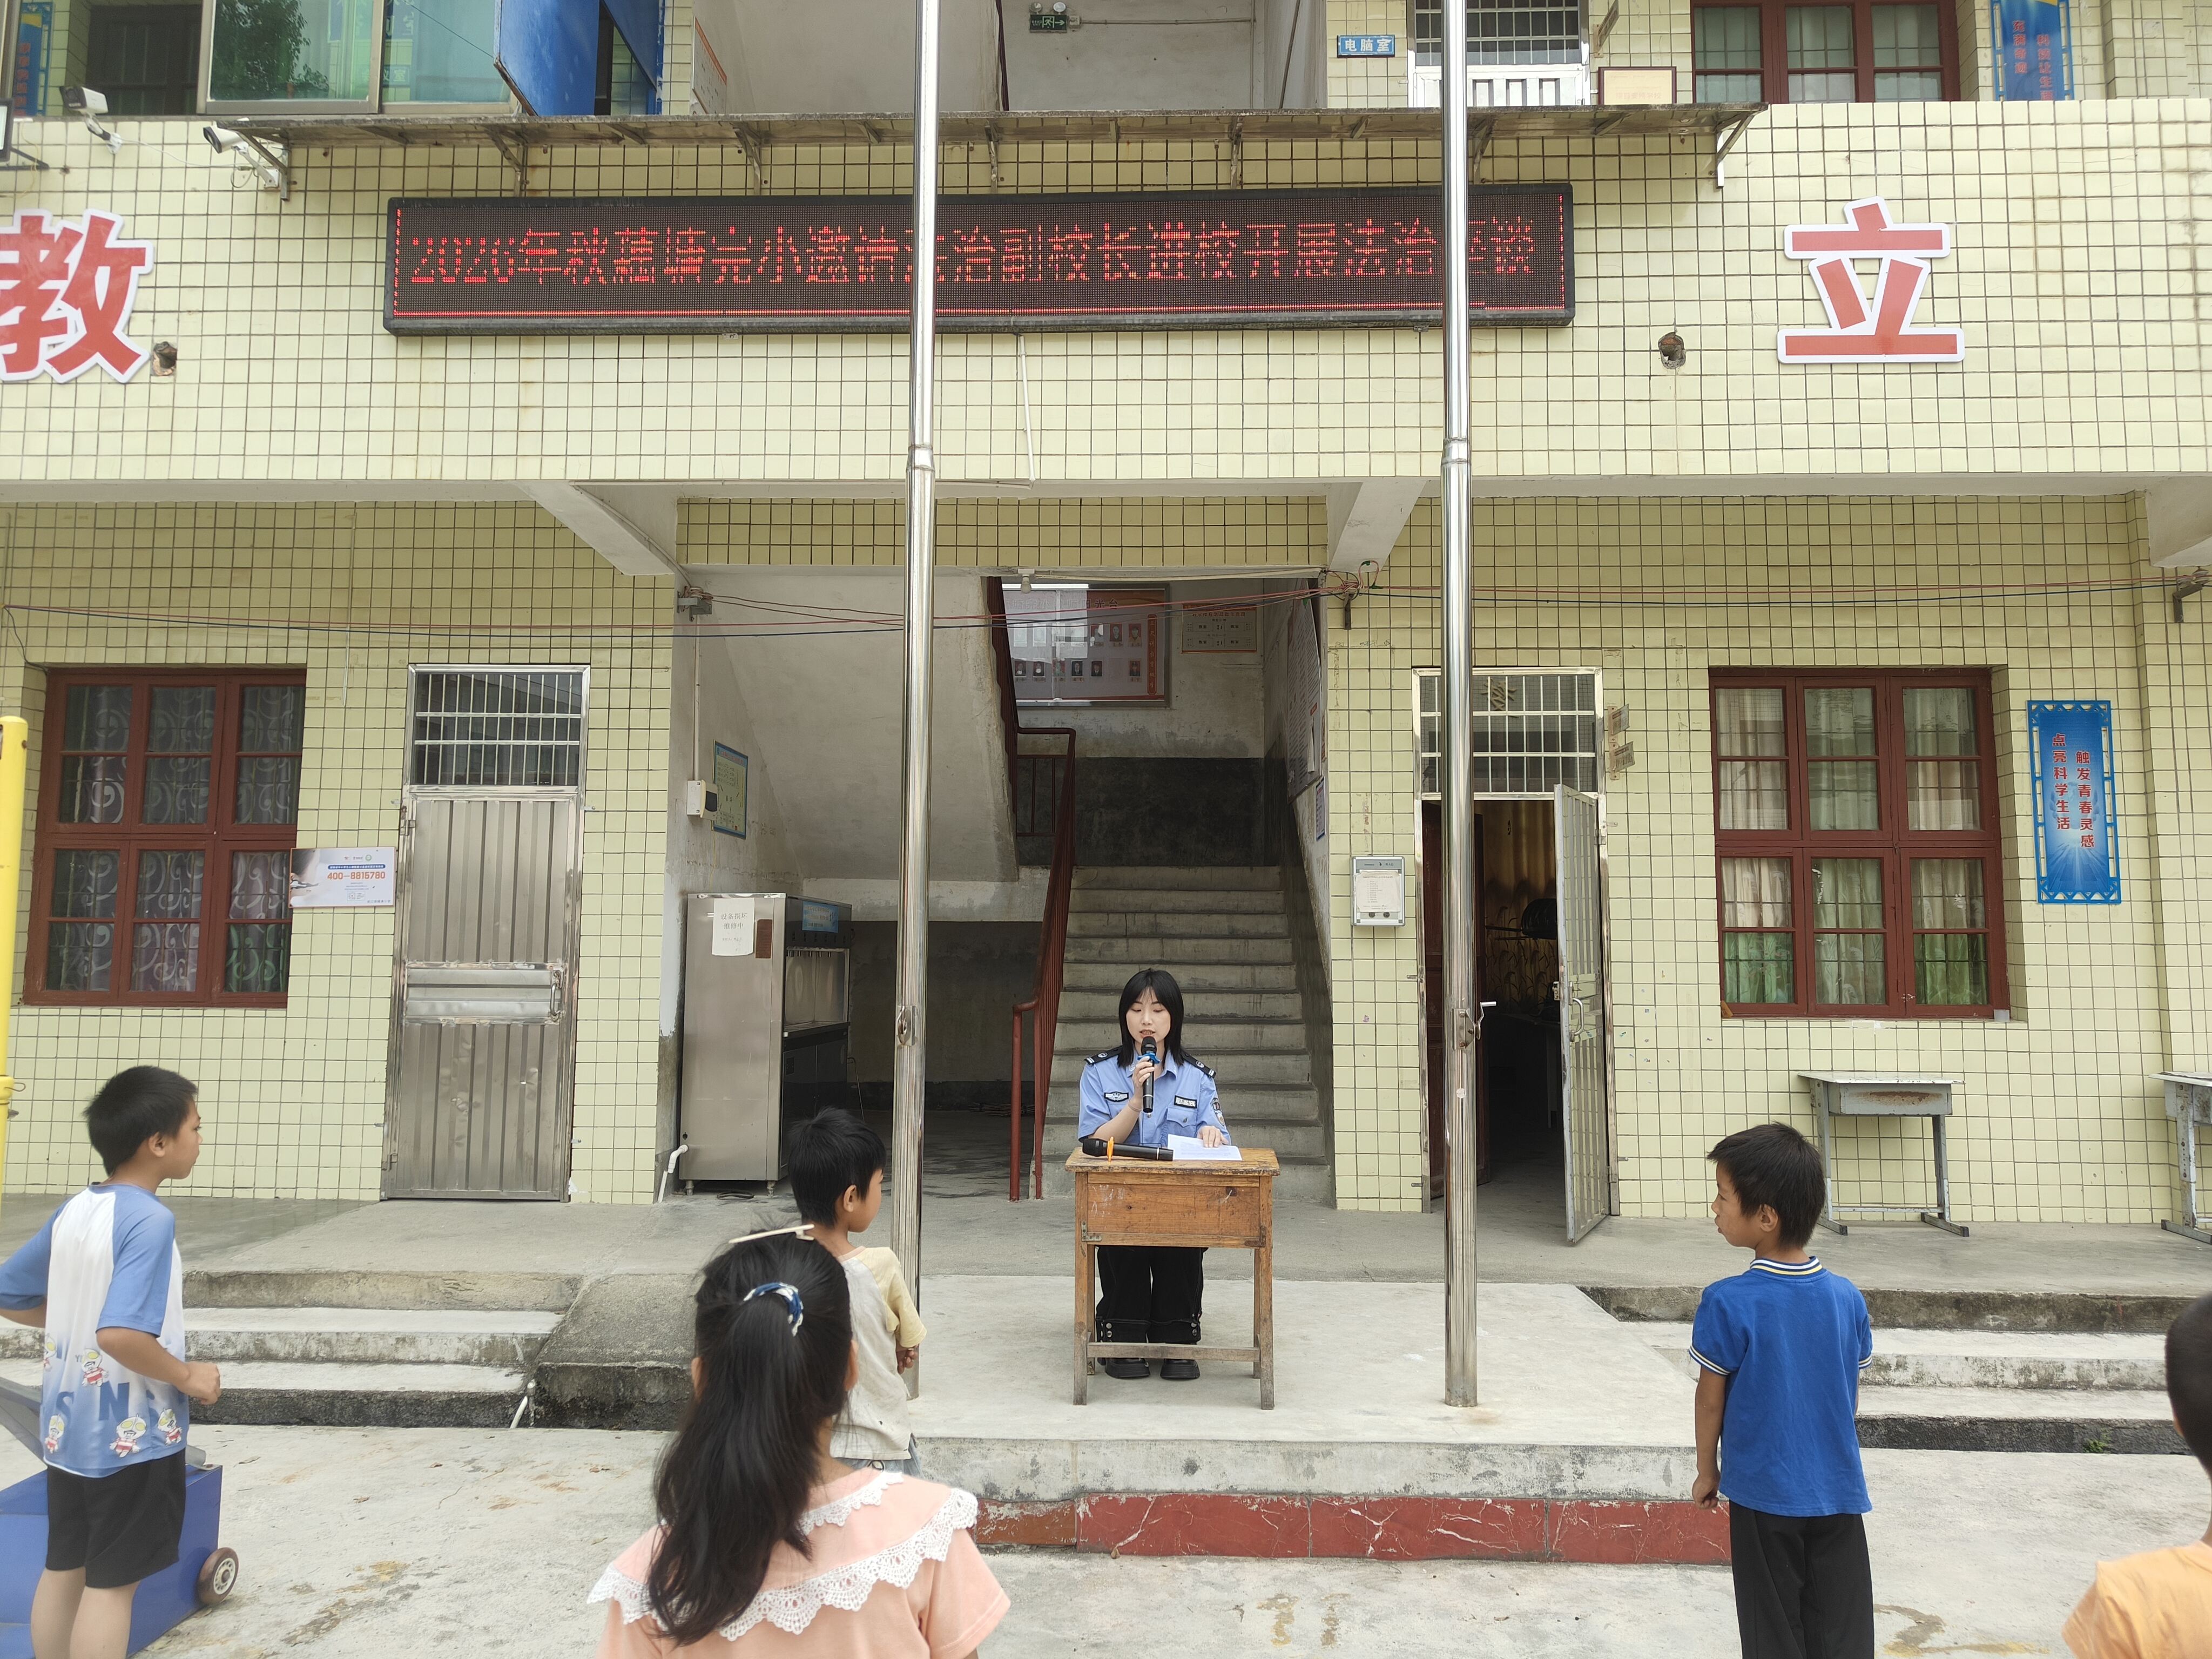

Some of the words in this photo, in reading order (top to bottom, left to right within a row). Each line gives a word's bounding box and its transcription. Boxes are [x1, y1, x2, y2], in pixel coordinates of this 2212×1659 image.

[1345, 38, 1392, 52] 电脑室
[0, 214, 147, 376] 教
[1784, 203, 1958, 356] 立
[2052, 732, 2070, 831] 点亮科学生活
[2075, 750, 2095, 848] 触发青春灵感
[721, 912, 748, 920] 设备损坏
[723, 922, 744, 930] 维修中
